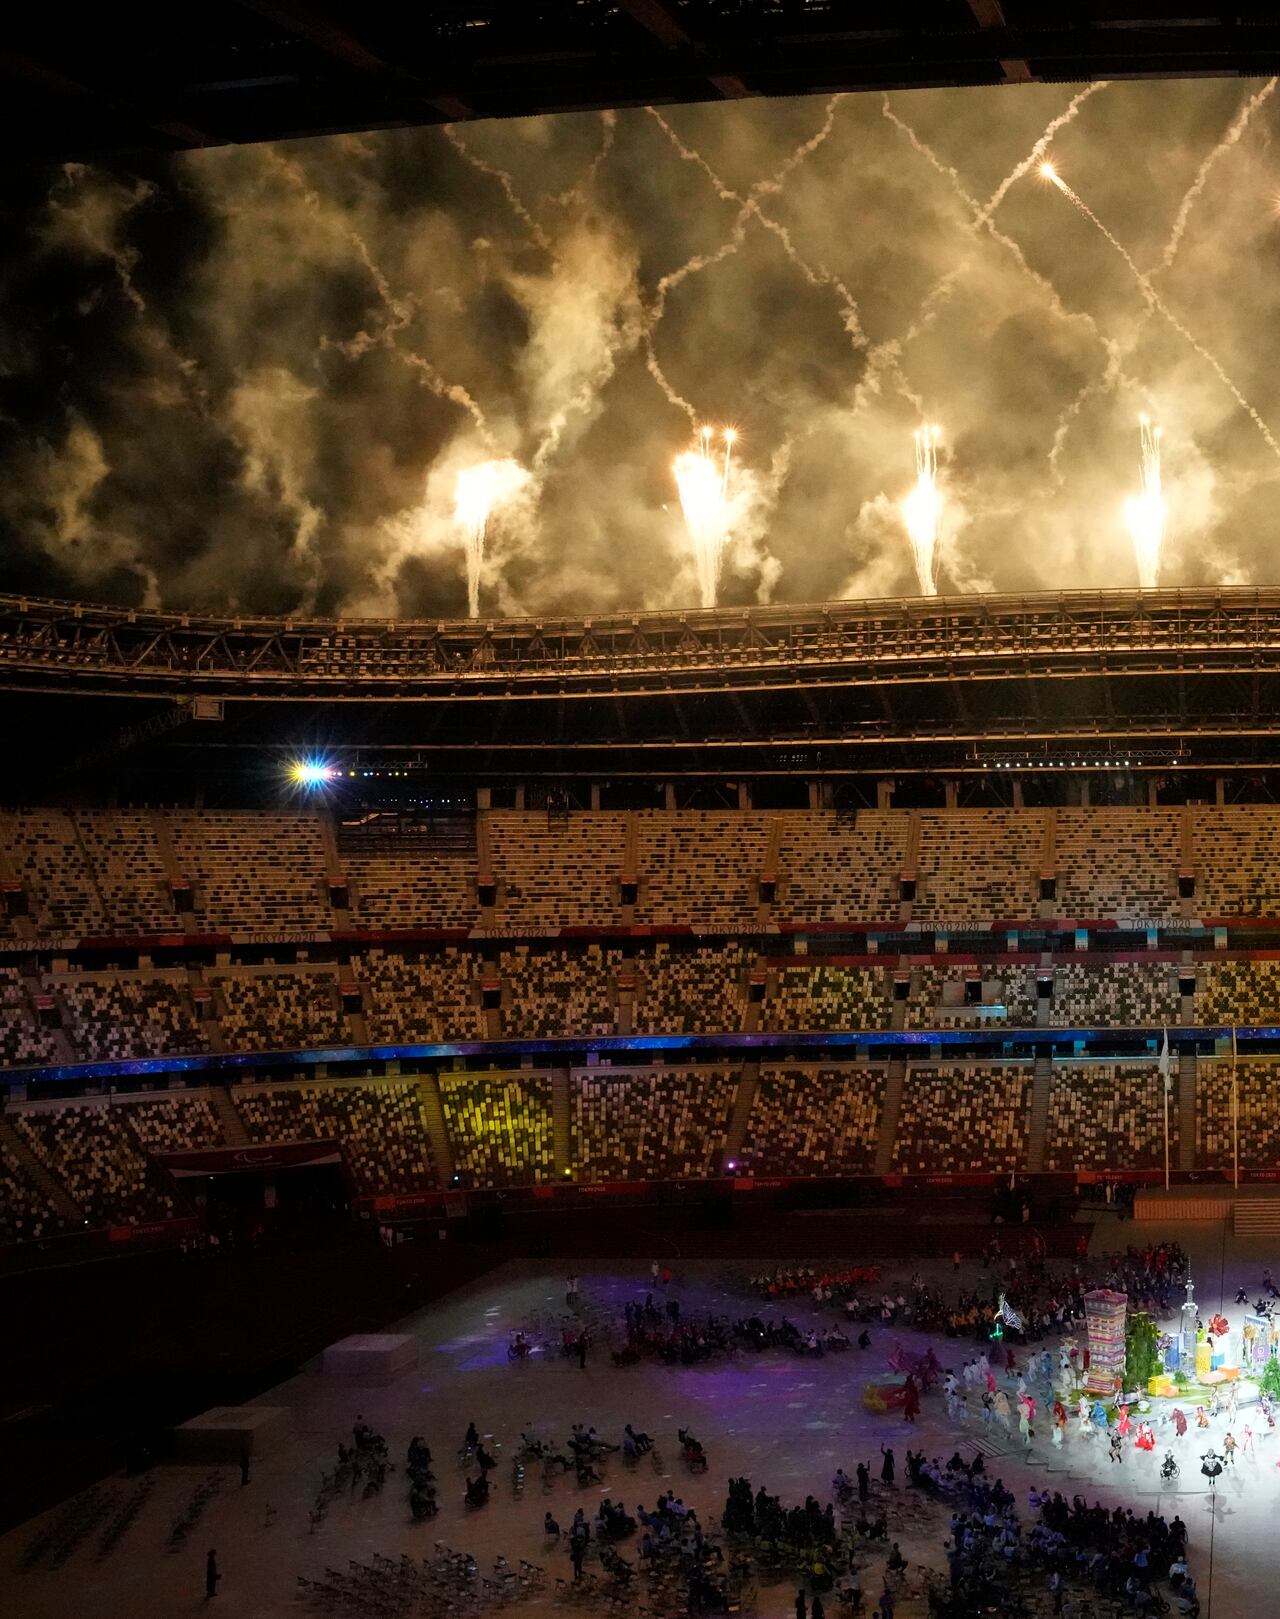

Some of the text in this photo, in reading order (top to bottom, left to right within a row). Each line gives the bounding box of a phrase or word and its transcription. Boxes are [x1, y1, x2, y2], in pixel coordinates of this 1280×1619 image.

[920, 921, 979, 931] TOKYO 2020
[1131, 919, 1191, 928] TOKYO 2020
[483, 928, 547, 938] TOKYO 2020
[705, 924, 767, 934] TOKYO 2020
[248, 932, 316, 943] TOKYO 2020
[32, 939, 62, 950] 2020
